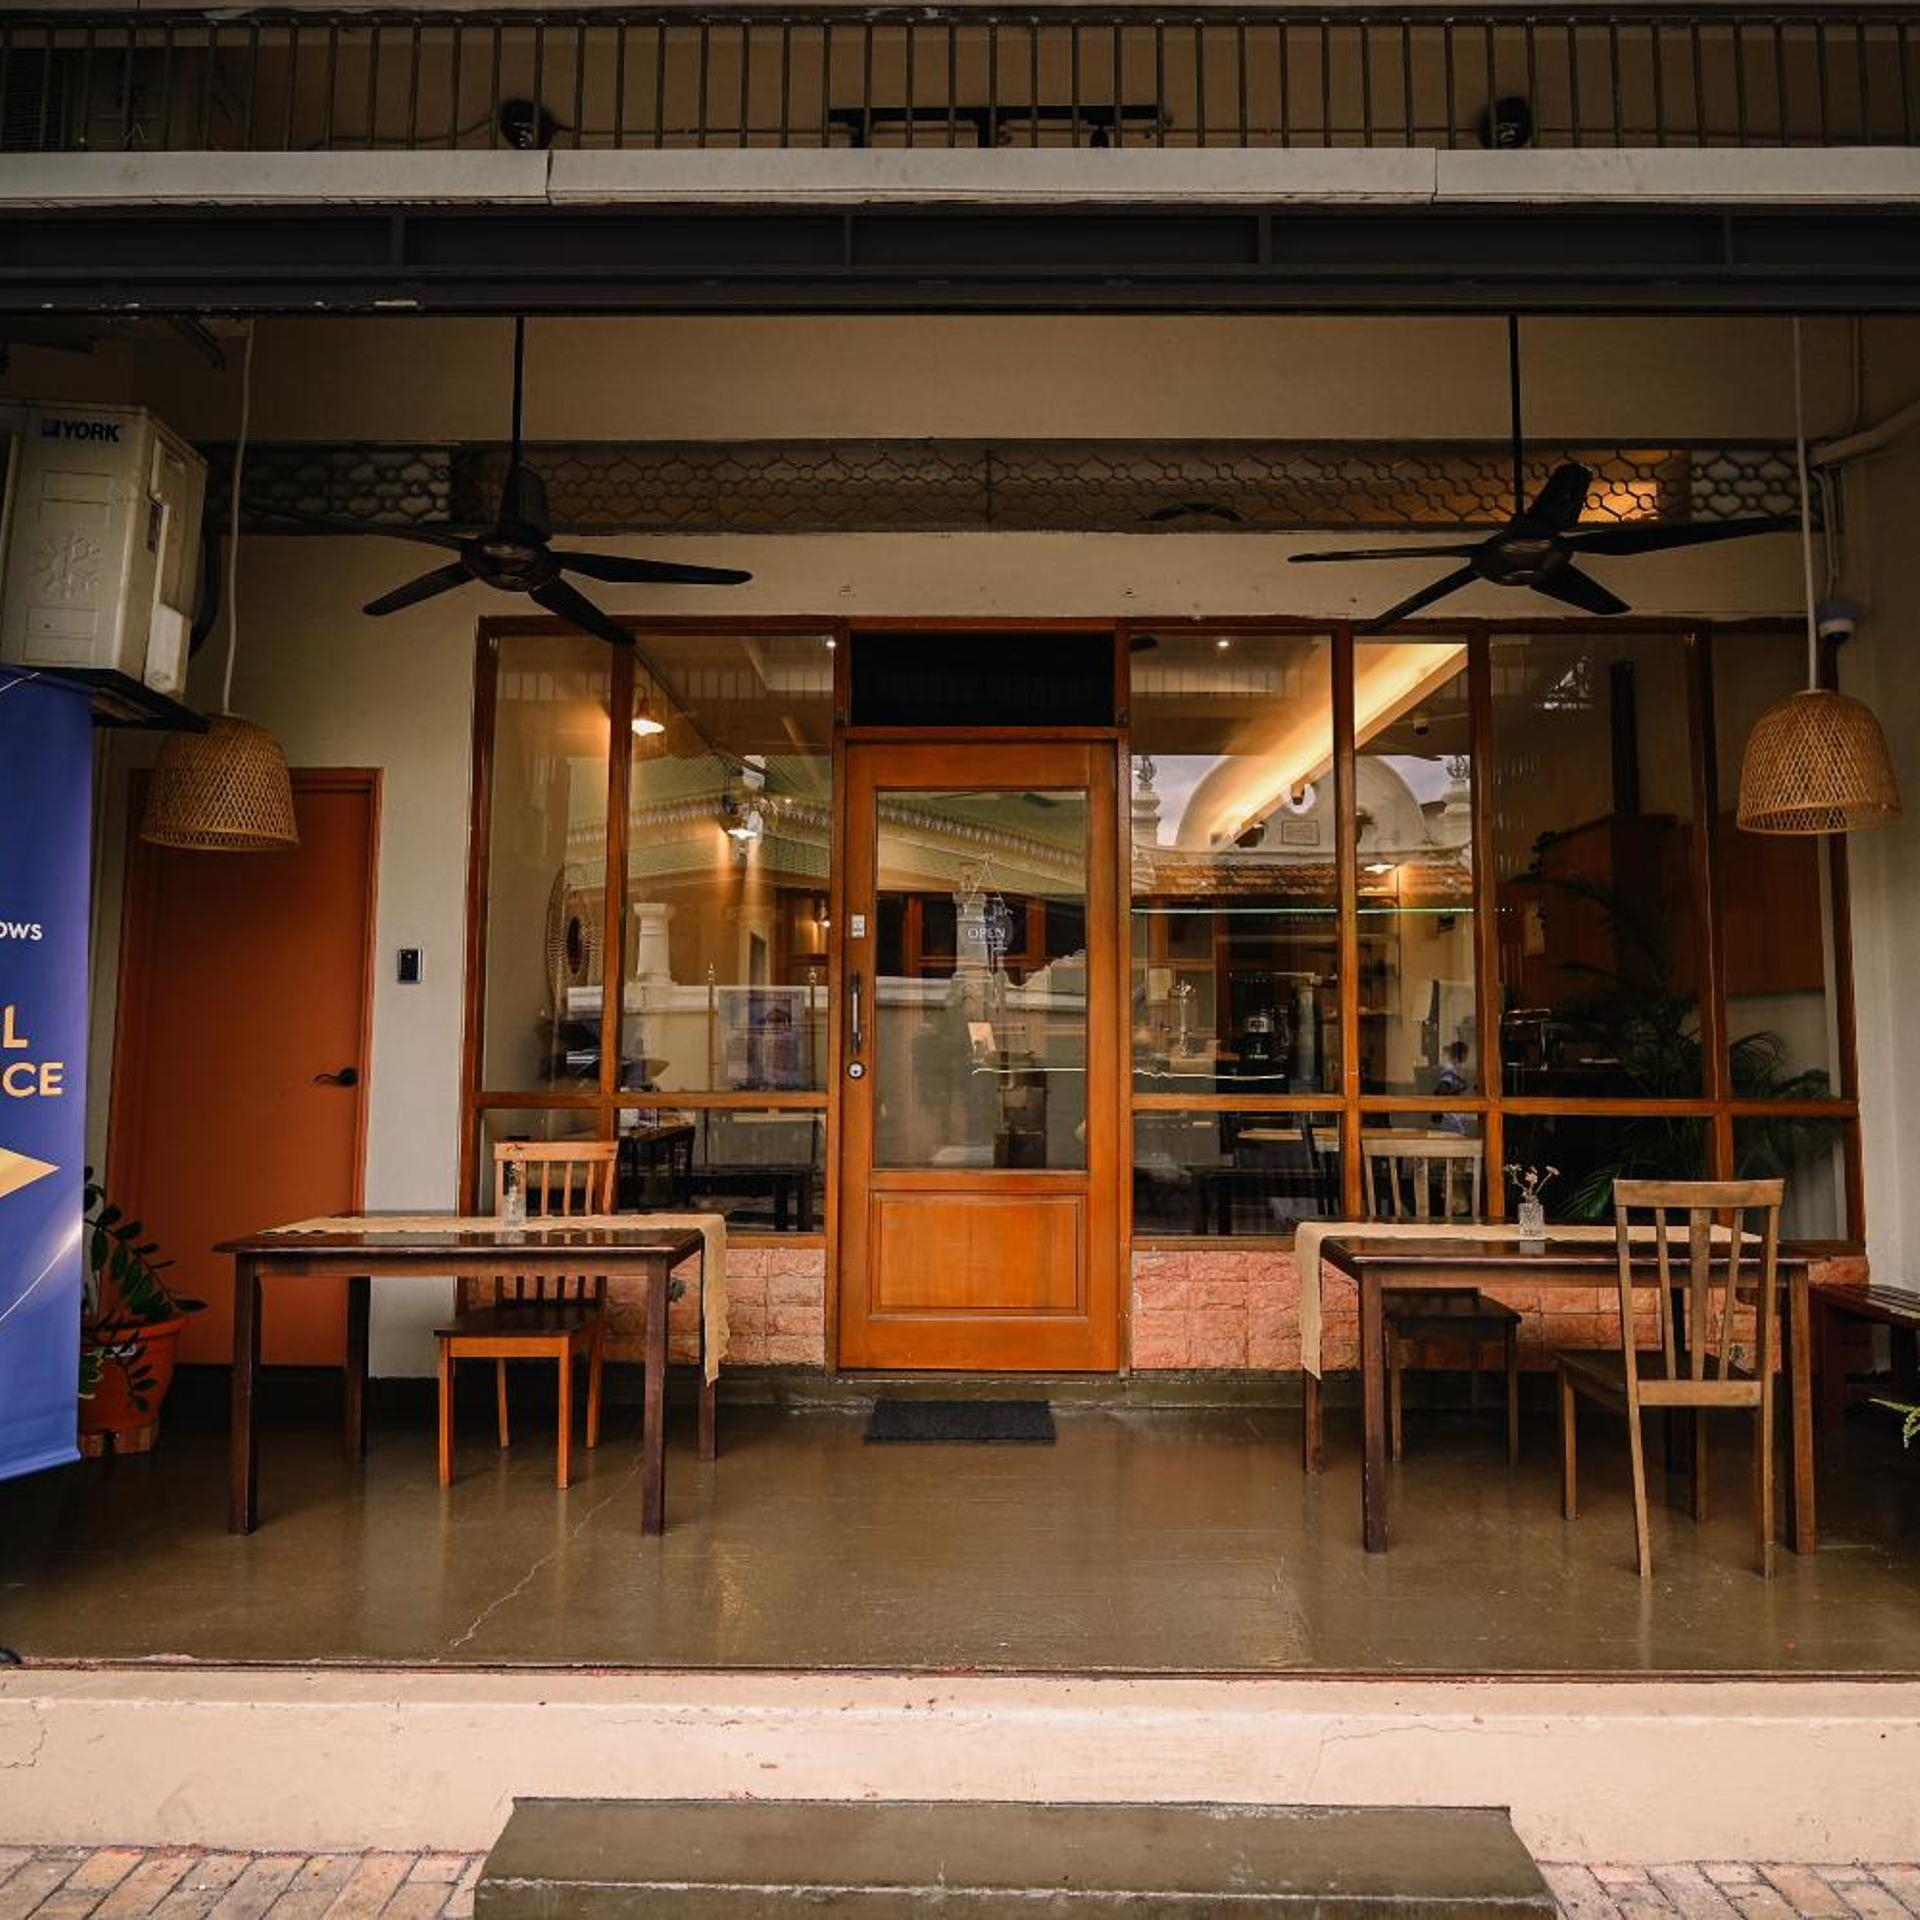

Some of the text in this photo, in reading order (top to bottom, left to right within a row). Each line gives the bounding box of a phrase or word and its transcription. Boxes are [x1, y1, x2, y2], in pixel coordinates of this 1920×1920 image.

[61, 421, 119, 442] YORK
[967, 927, 1006, 939] OPEN
[2, 1062, 64, 1098] CE
